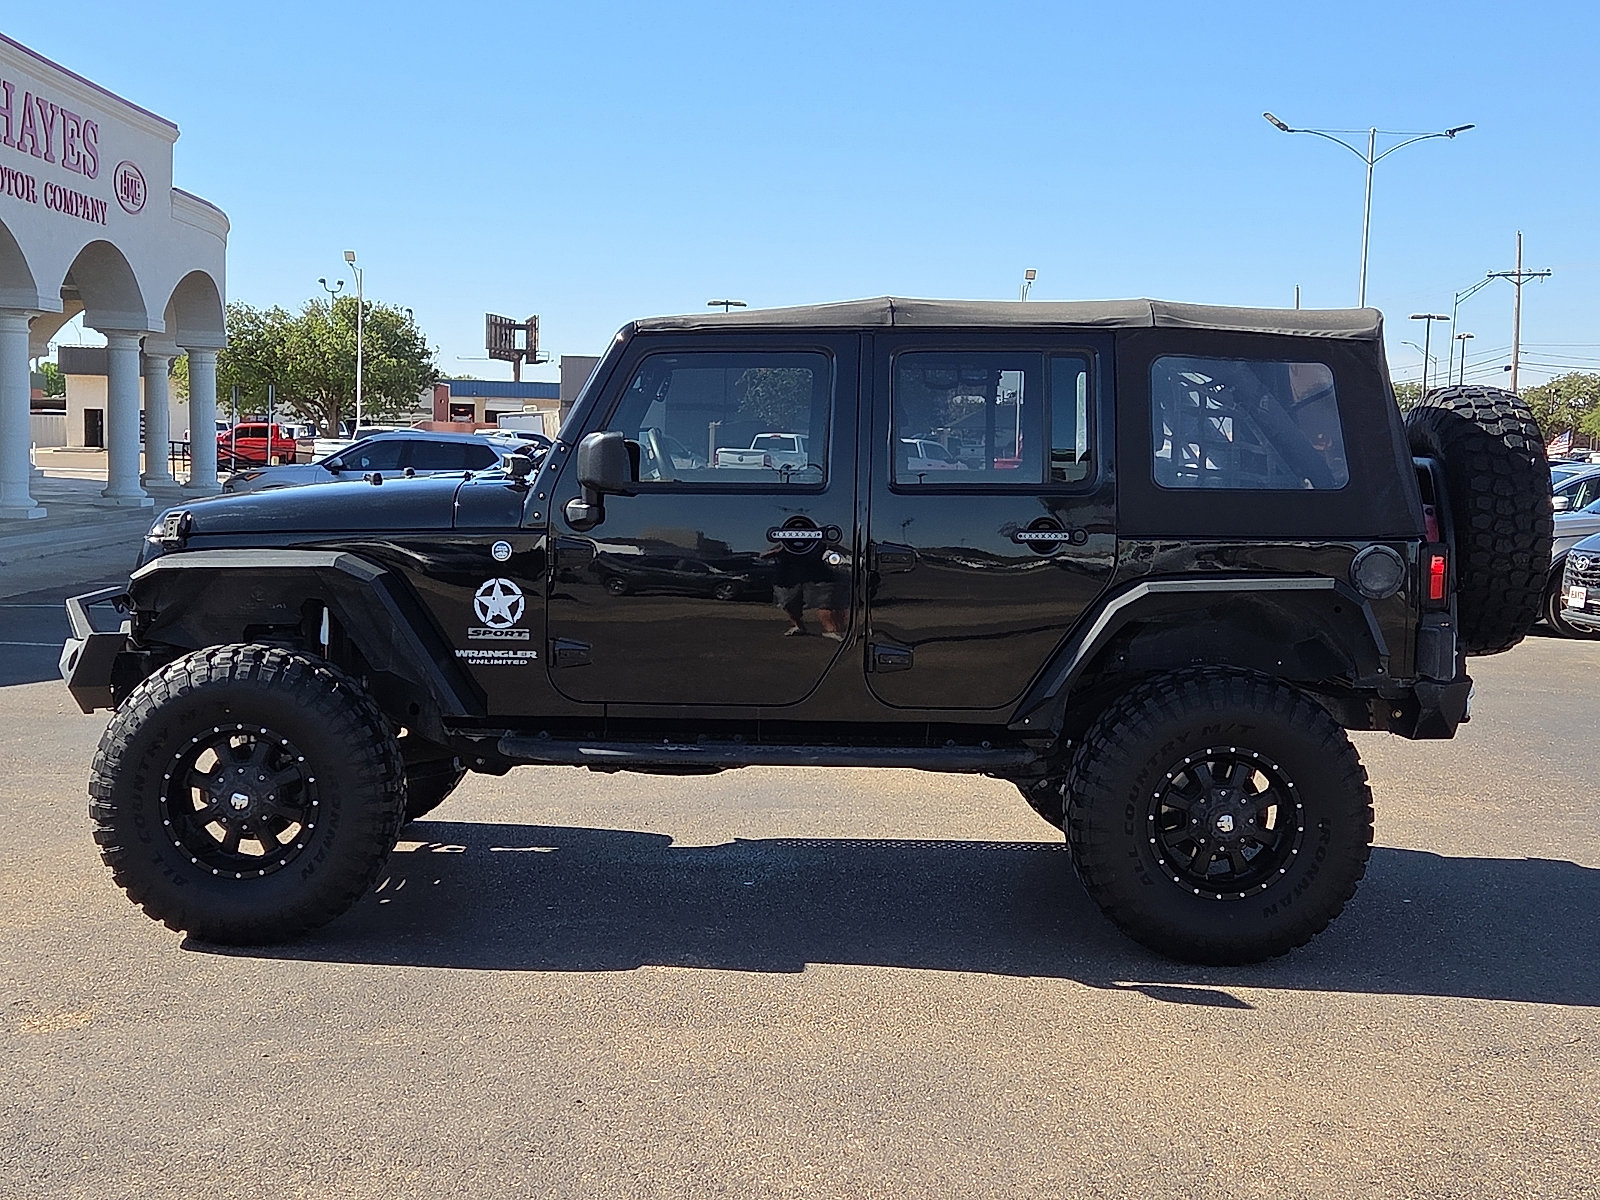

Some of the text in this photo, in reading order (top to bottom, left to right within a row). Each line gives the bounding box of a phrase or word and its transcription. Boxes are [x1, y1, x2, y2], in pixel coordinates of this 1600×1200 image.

[0, 80, 99, 179] HAYES
[43, 181, 107, 226] COMPANY
[455, 649, 538, 659] WRANGLER
[468, 628, 529, 638] SPORT
[1123, 722, 1257, 887] ALL COUNTRY M/T
[1262, 816, 1331, 920] IRONMAN
